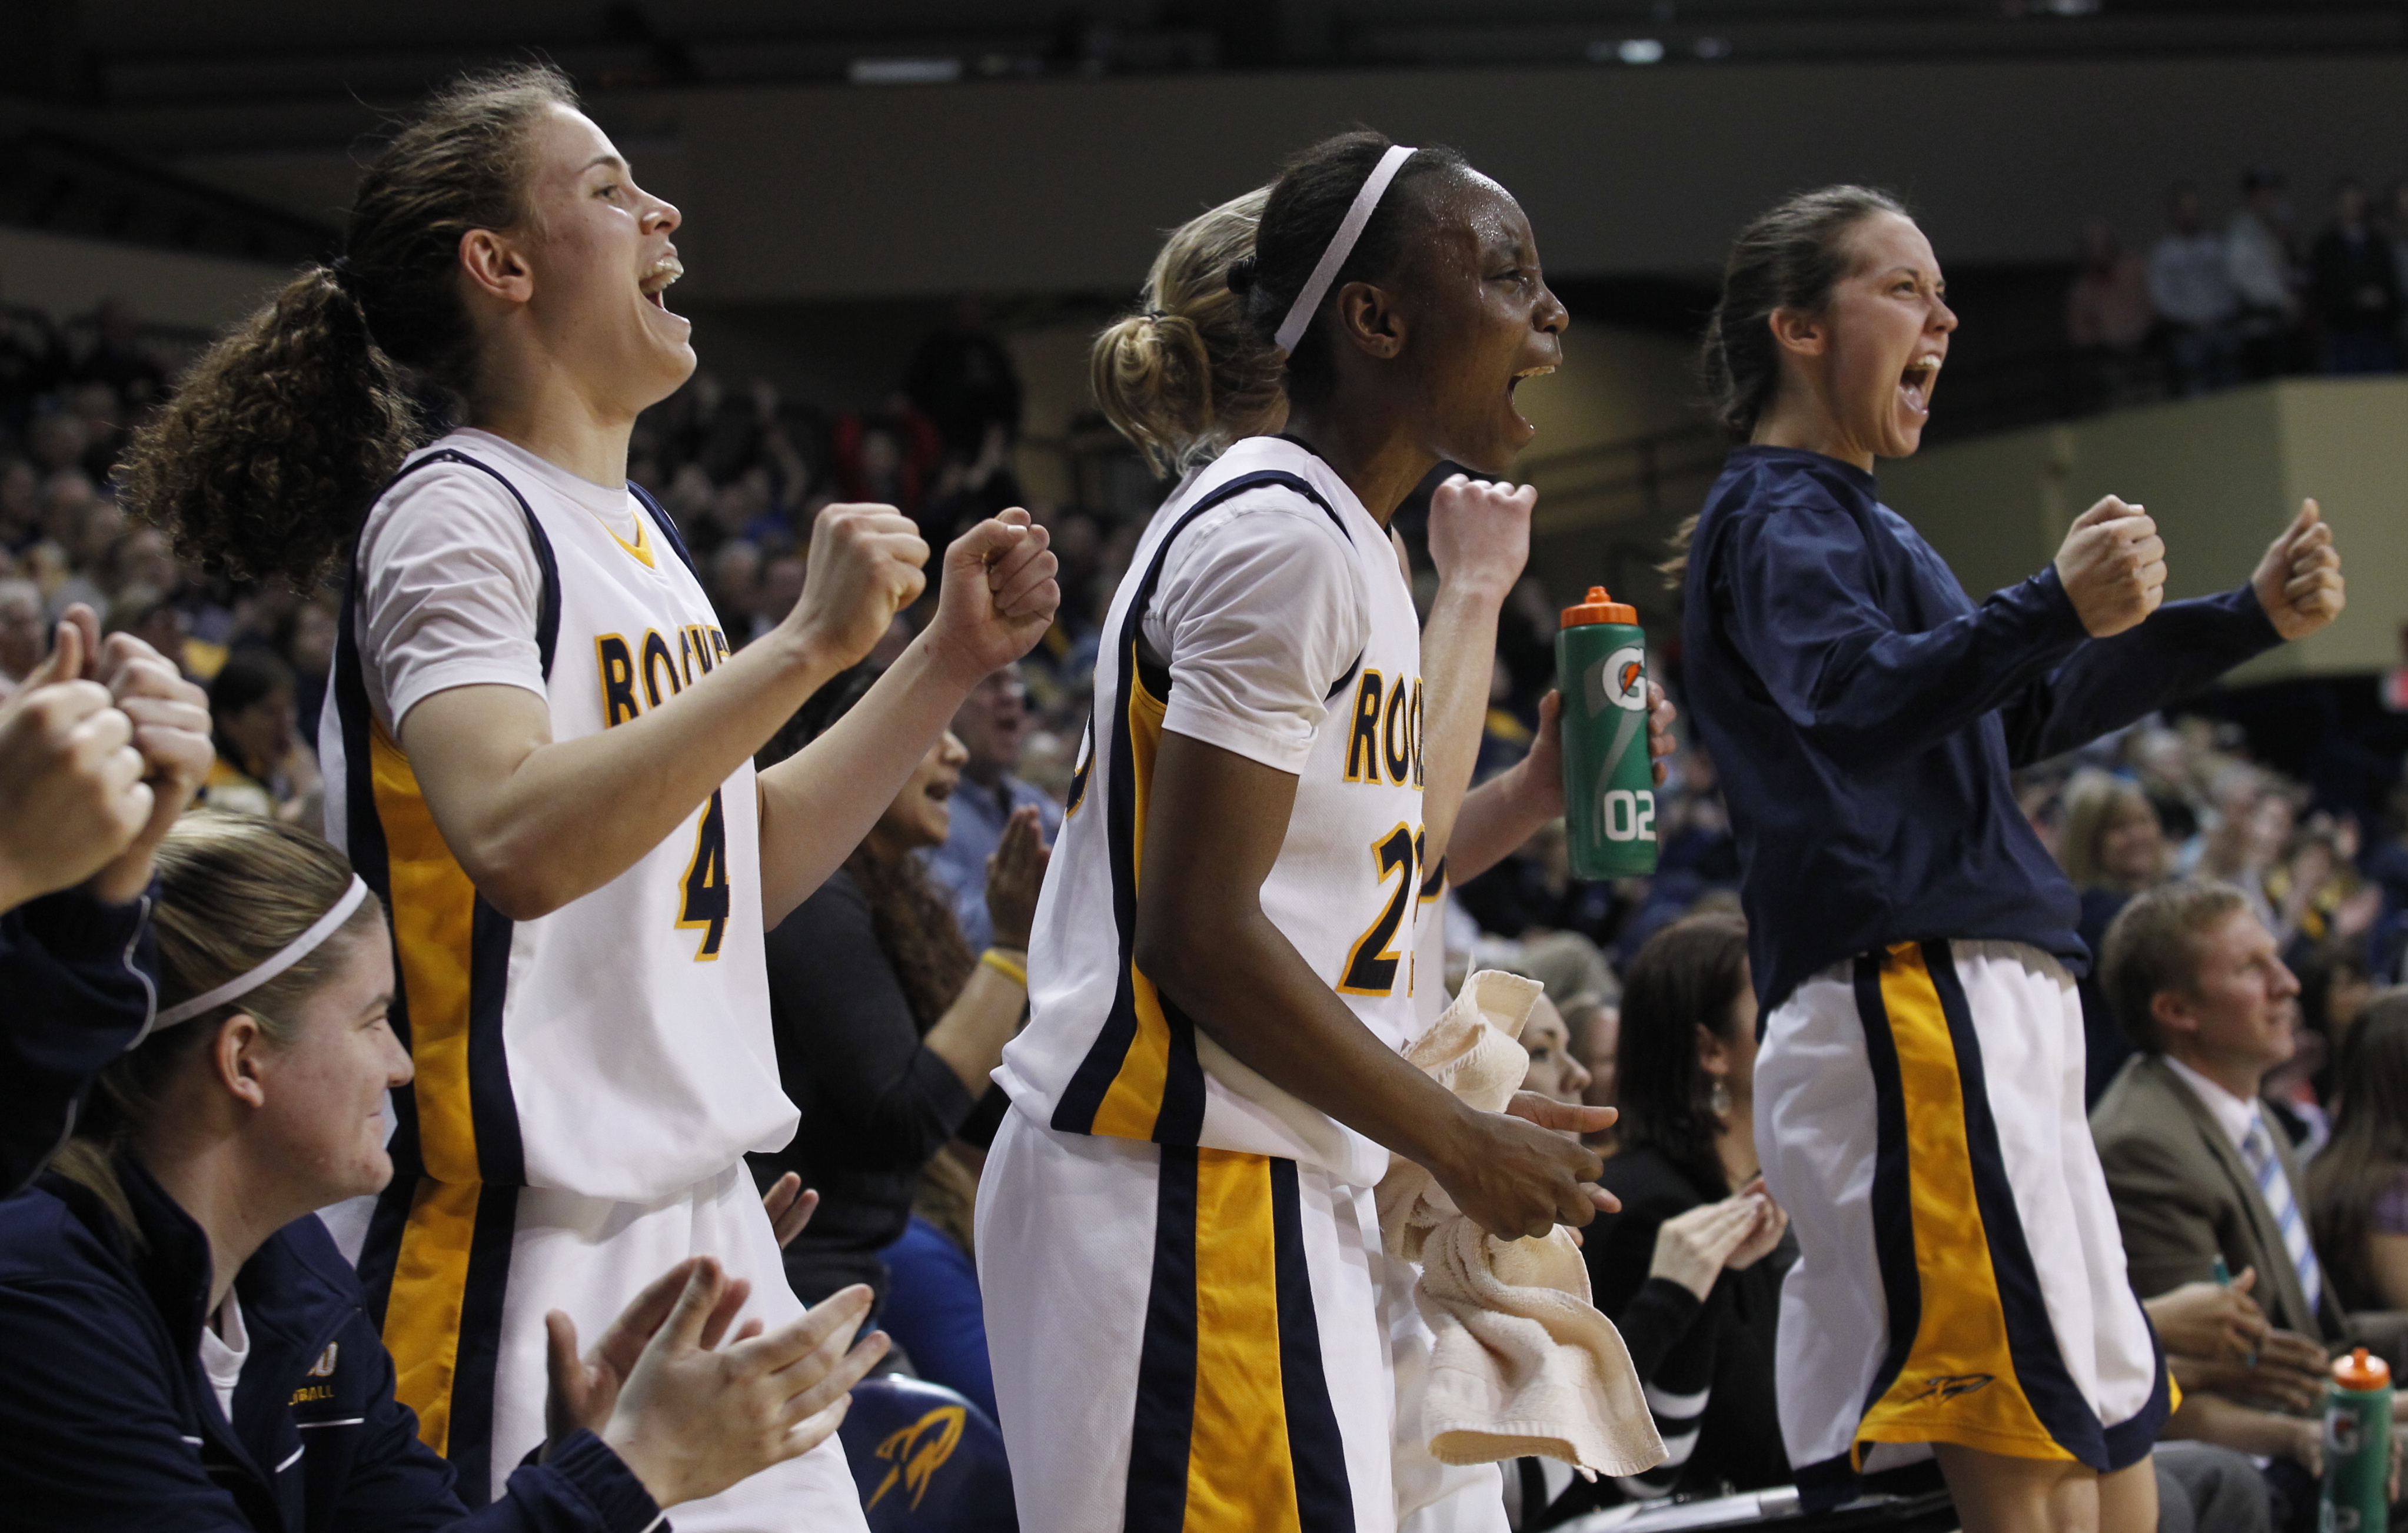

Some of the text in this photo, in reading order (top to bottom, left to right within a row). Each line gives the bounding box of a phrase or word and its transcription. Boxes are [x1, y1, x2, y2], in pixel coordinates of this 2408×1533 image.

[1602, 646, 1648, 711] G
[1604, 789, 1656, 842] 02
[674, 786, 730, 962] 4
